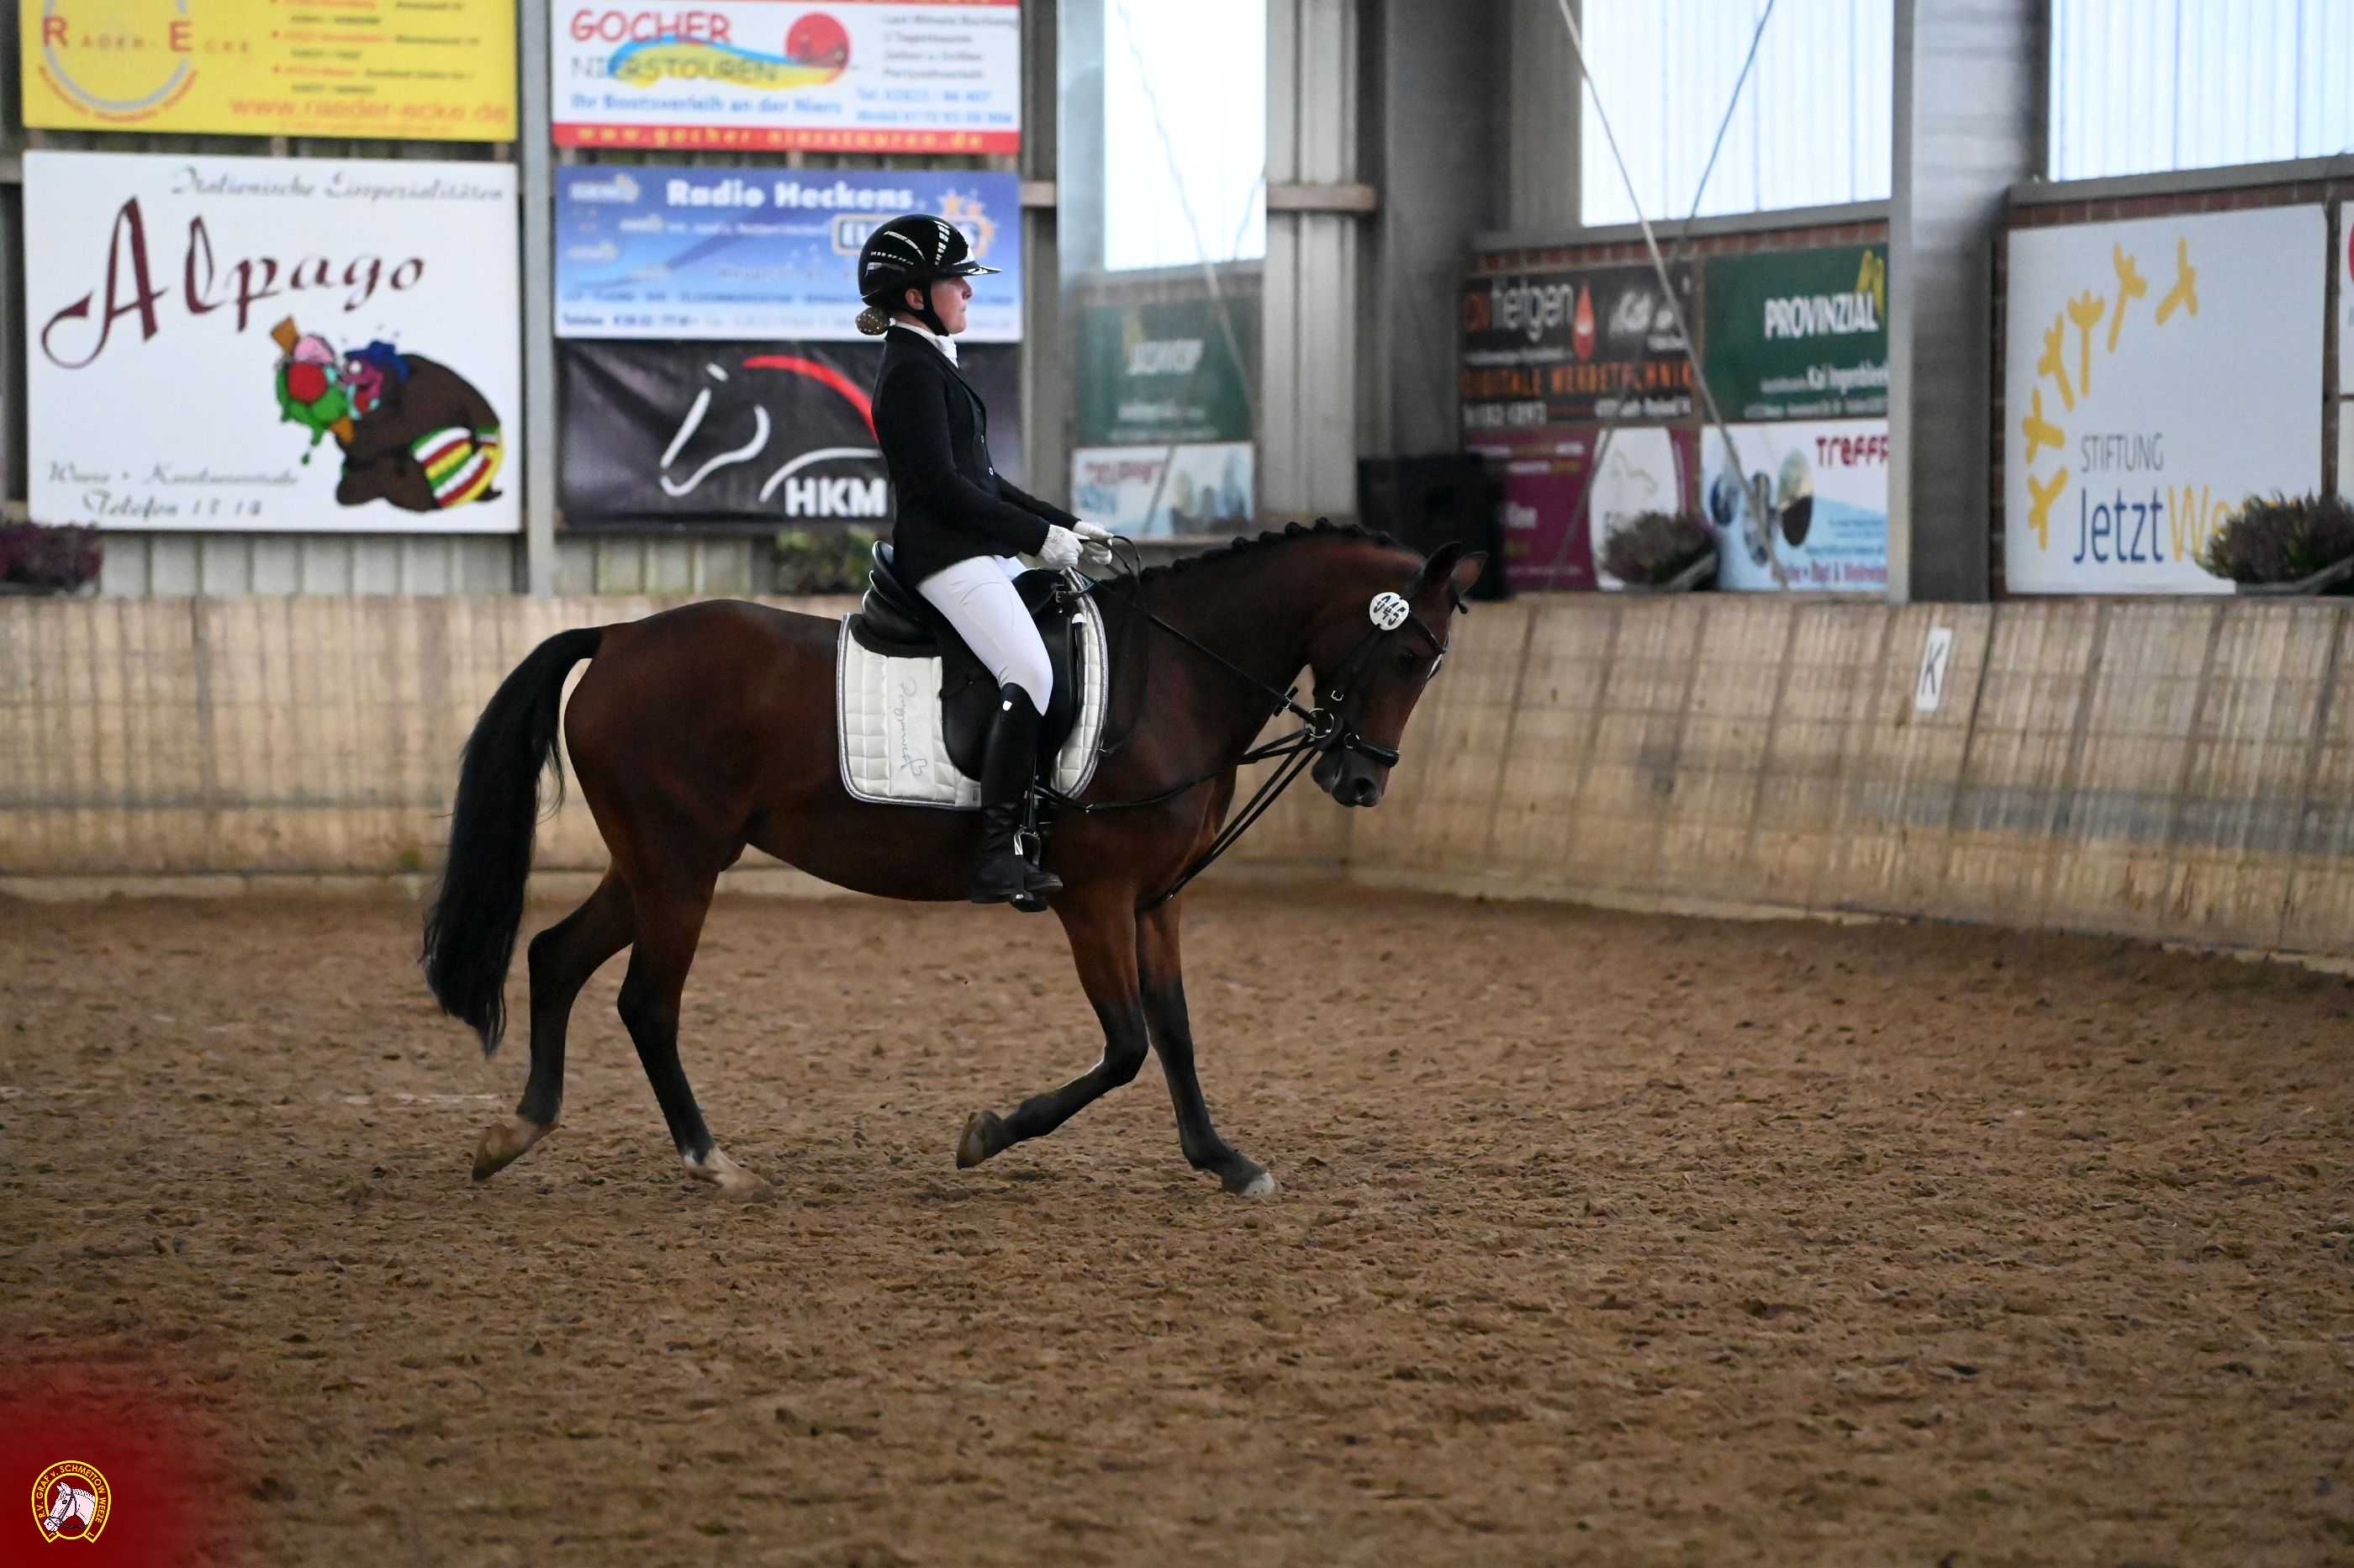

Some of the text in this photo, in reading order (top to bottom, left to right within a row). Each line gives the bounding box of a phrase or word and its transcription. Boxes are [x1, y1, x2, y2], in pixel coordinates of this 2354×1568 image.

[570, 8, 731, 45] GOCHER
[571, 55, 779, 82] NIERSTOUREN
[666, 178, 766, 208] Radio
[773, 180, 915, 209] Heckens
[41, 196, 425, 370] Alpago
[1764, 292, 1879, 341] PROVINZIAL
[2080, 433, 2166, 473] STIFTUNG
[82, 488, 179, 521] Telefon
[784, 476, 888, 517] HKM
[1920, 641, 1945, 695] K
